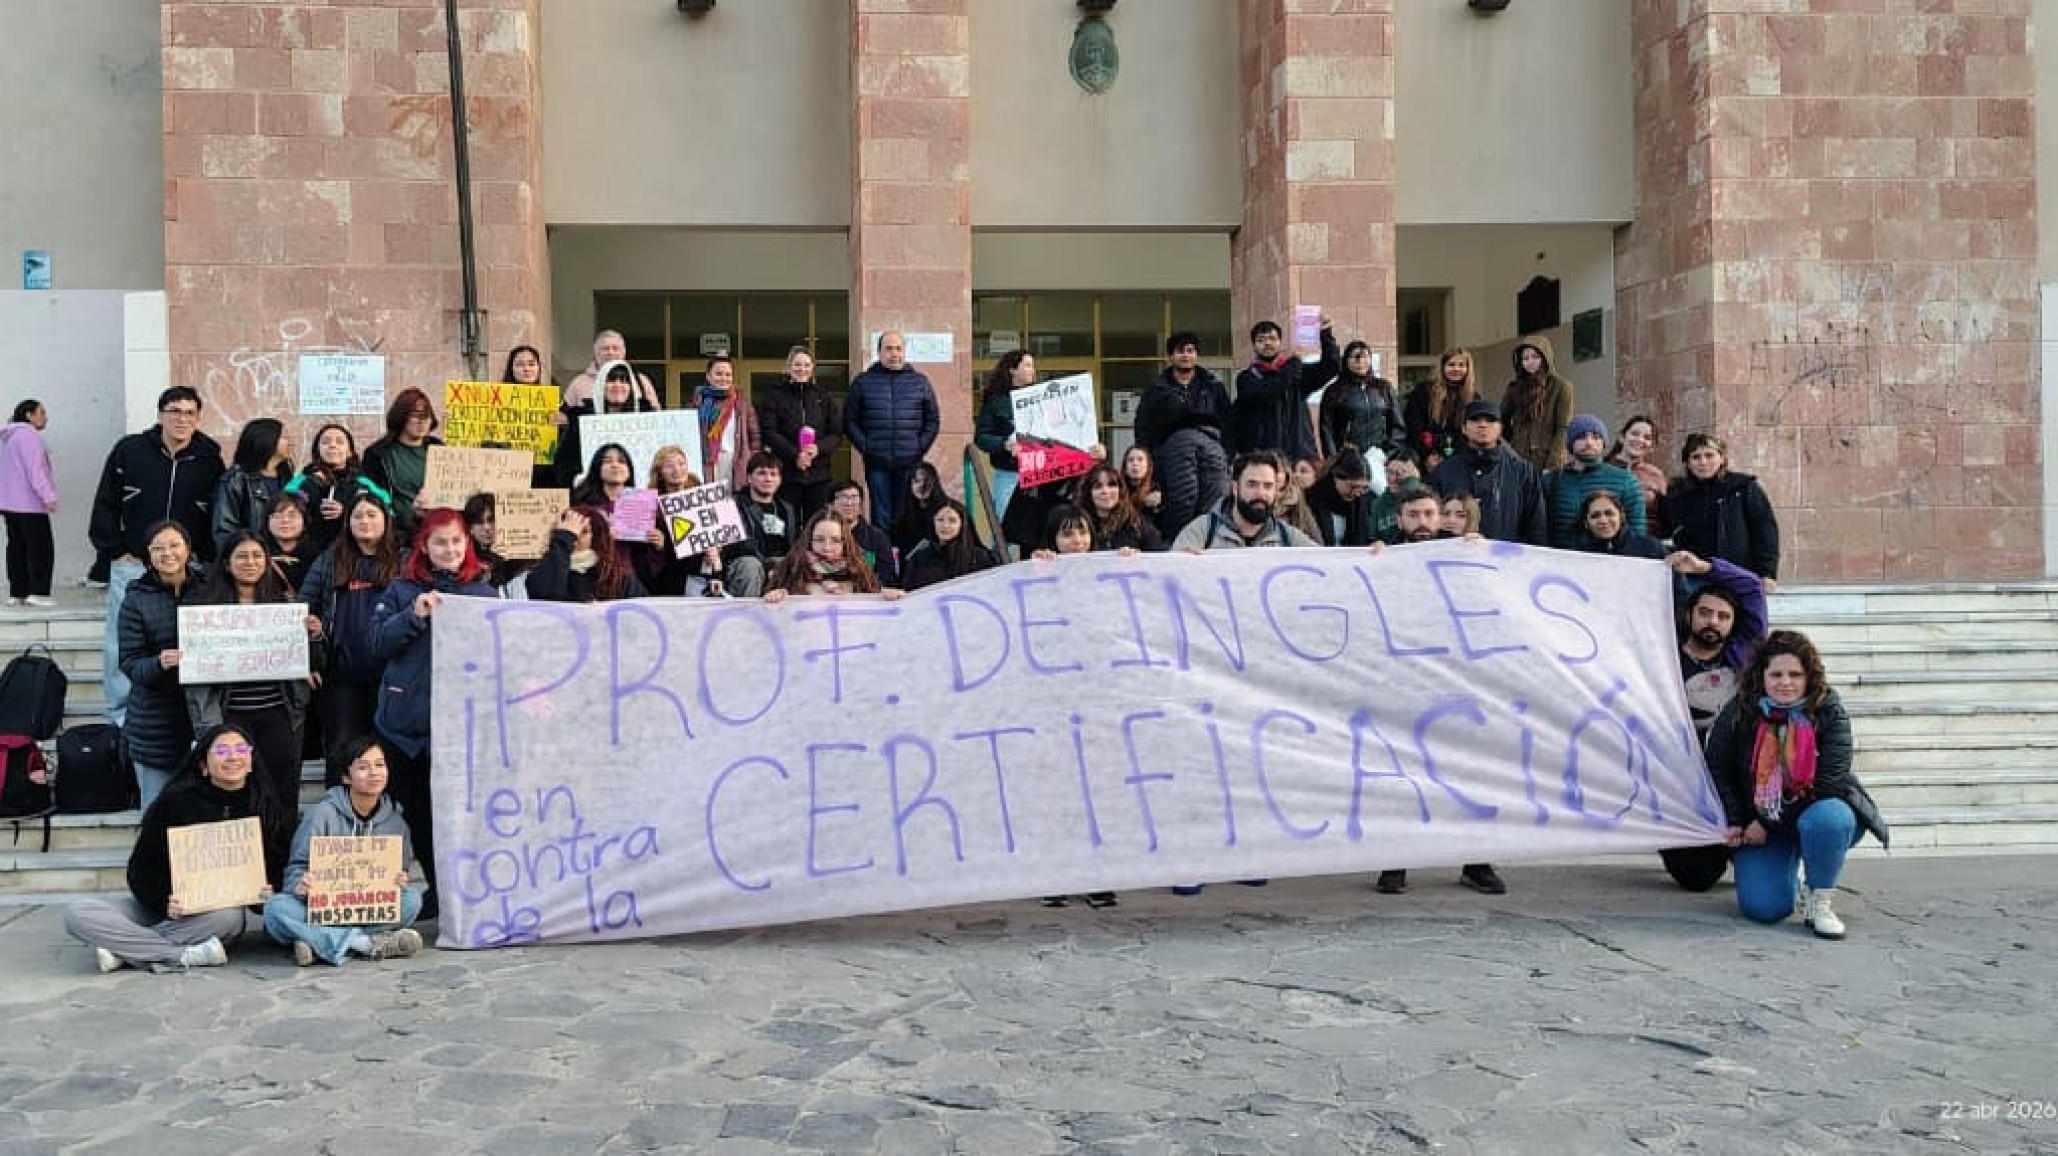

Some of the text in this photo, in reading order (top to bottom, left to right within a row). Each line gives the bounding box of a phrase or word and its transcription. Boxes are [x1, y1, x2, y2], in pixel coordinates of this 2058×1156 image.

[1019, 450, 1046, 471] NO
[697, 507, 719, 527] EN
[687, 524, 740, 554] PELIGRO
[935, 576, 1084, 692] DE
[485, 784, 578, 838] en
[452, 815, 660, 902] contra
[309, 893, 329, 908] NO
[310, 905, 397, 924] NOSOTRAS
[586, 874, 643, 933] la
